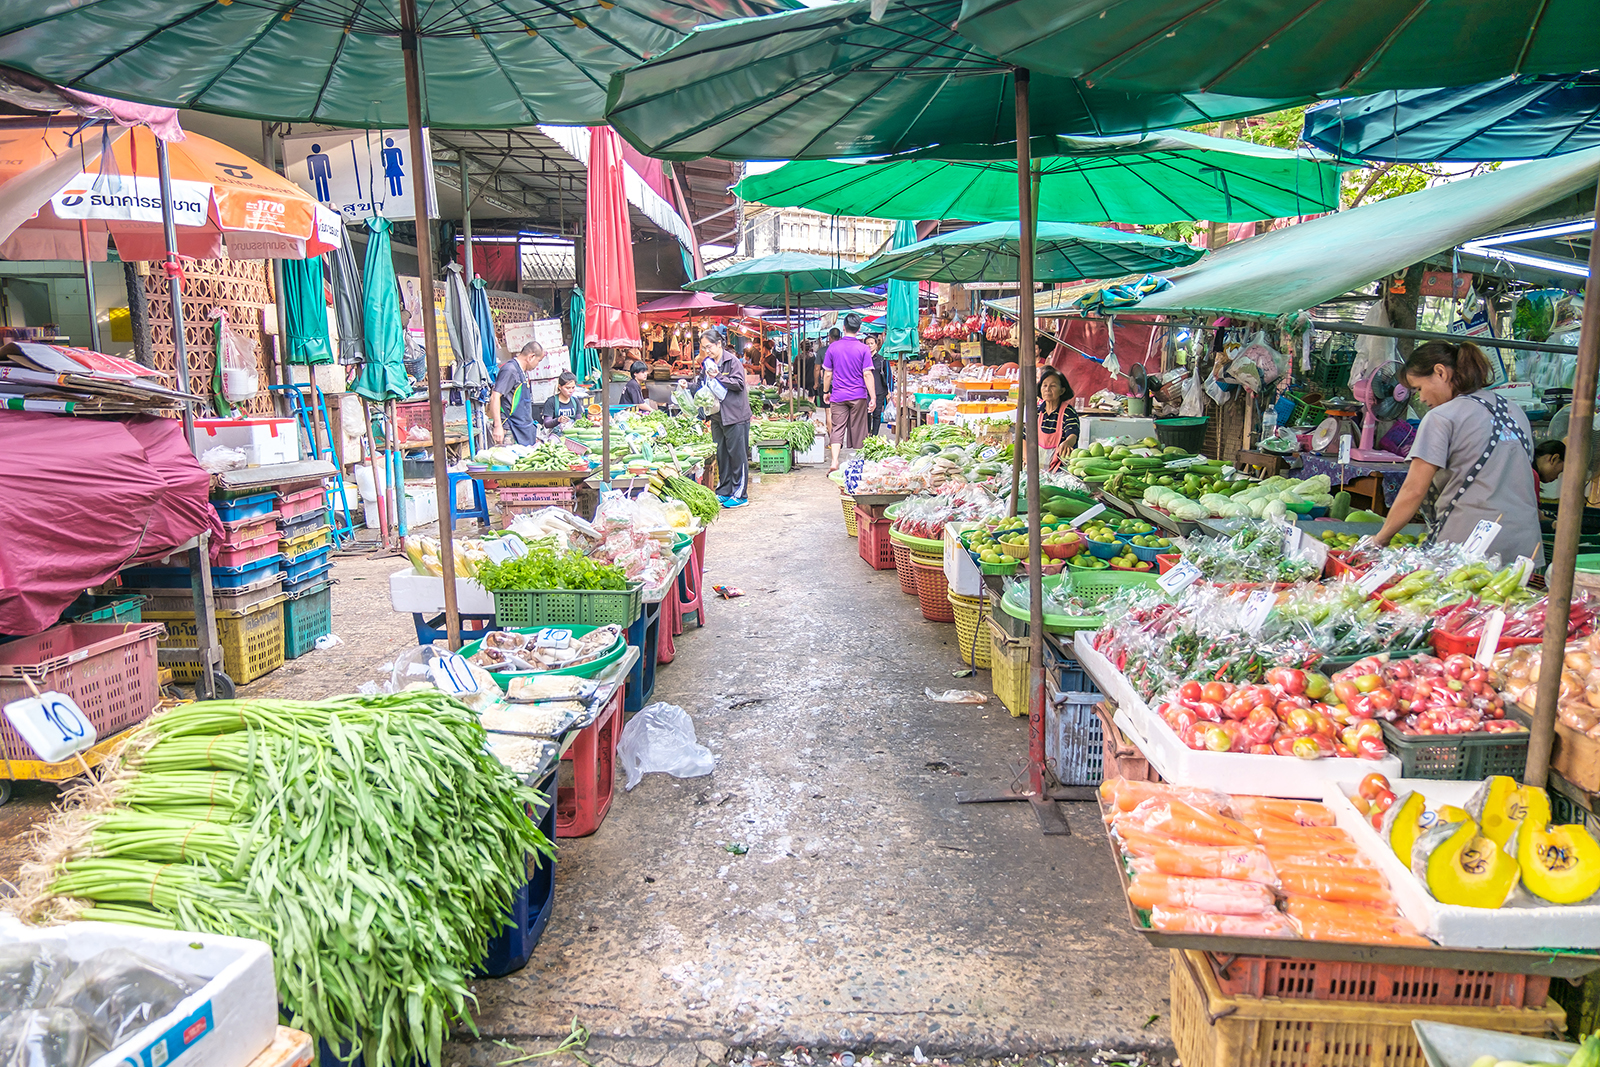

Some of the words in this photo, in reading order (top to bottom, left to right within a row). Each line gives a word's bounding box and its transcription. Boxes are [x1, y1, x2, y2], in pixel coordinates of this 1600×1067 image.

[90, 194, 200, 212] ธนาคารธชาต
[257, 200, 285, 214] 1770
[1163, 567, 1187, 587] 10
[543, 629, 568, 641] 10
[439, 654, 479, 694] 10
[41, 702, 84, 741] 10
